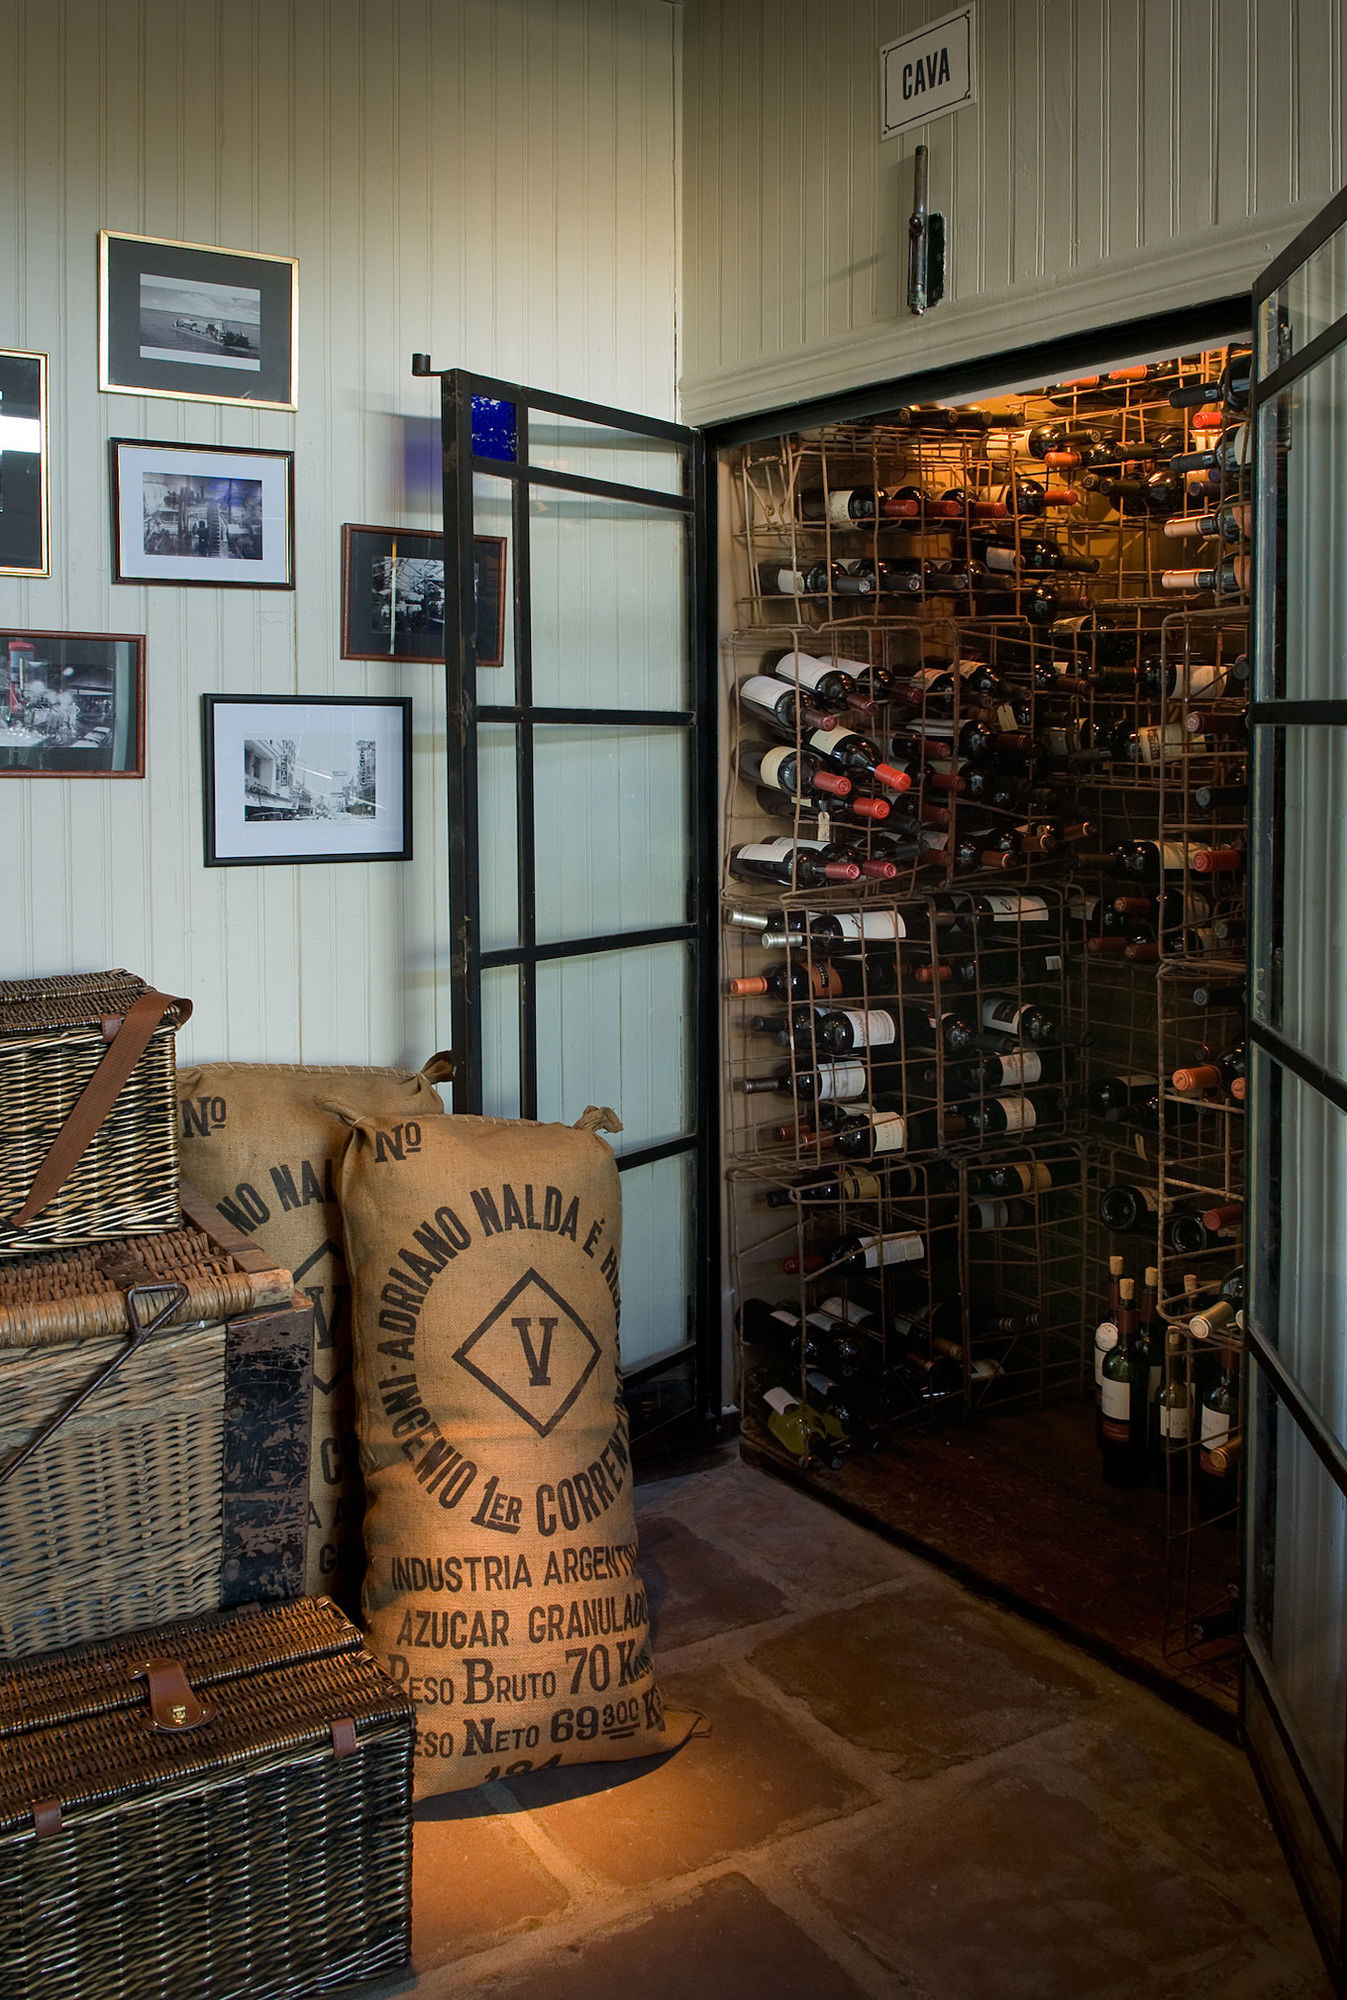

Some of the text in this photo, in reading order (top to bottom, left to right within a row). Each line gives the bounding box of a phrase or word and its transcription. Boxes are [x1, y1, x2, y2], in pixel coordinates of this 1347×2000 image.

[902, 47, 951, 101] CAVA
[377, 1206, 472, 1361] ADRIANO
[470, 1184, 581, 1244] NALDA
[511, 1317, 559, 1387] V
[378, 1373, 478, 1509] INGENIO
[470, 1475, 523, 1535] 1ER
[391, 1554, 533, 1592] INDUSTRIA
[396, 1609, 510, 1649] AZUCAR
[565, 1644, 610, 1695] 70
[414, 1731, 454, 1758] ESO
